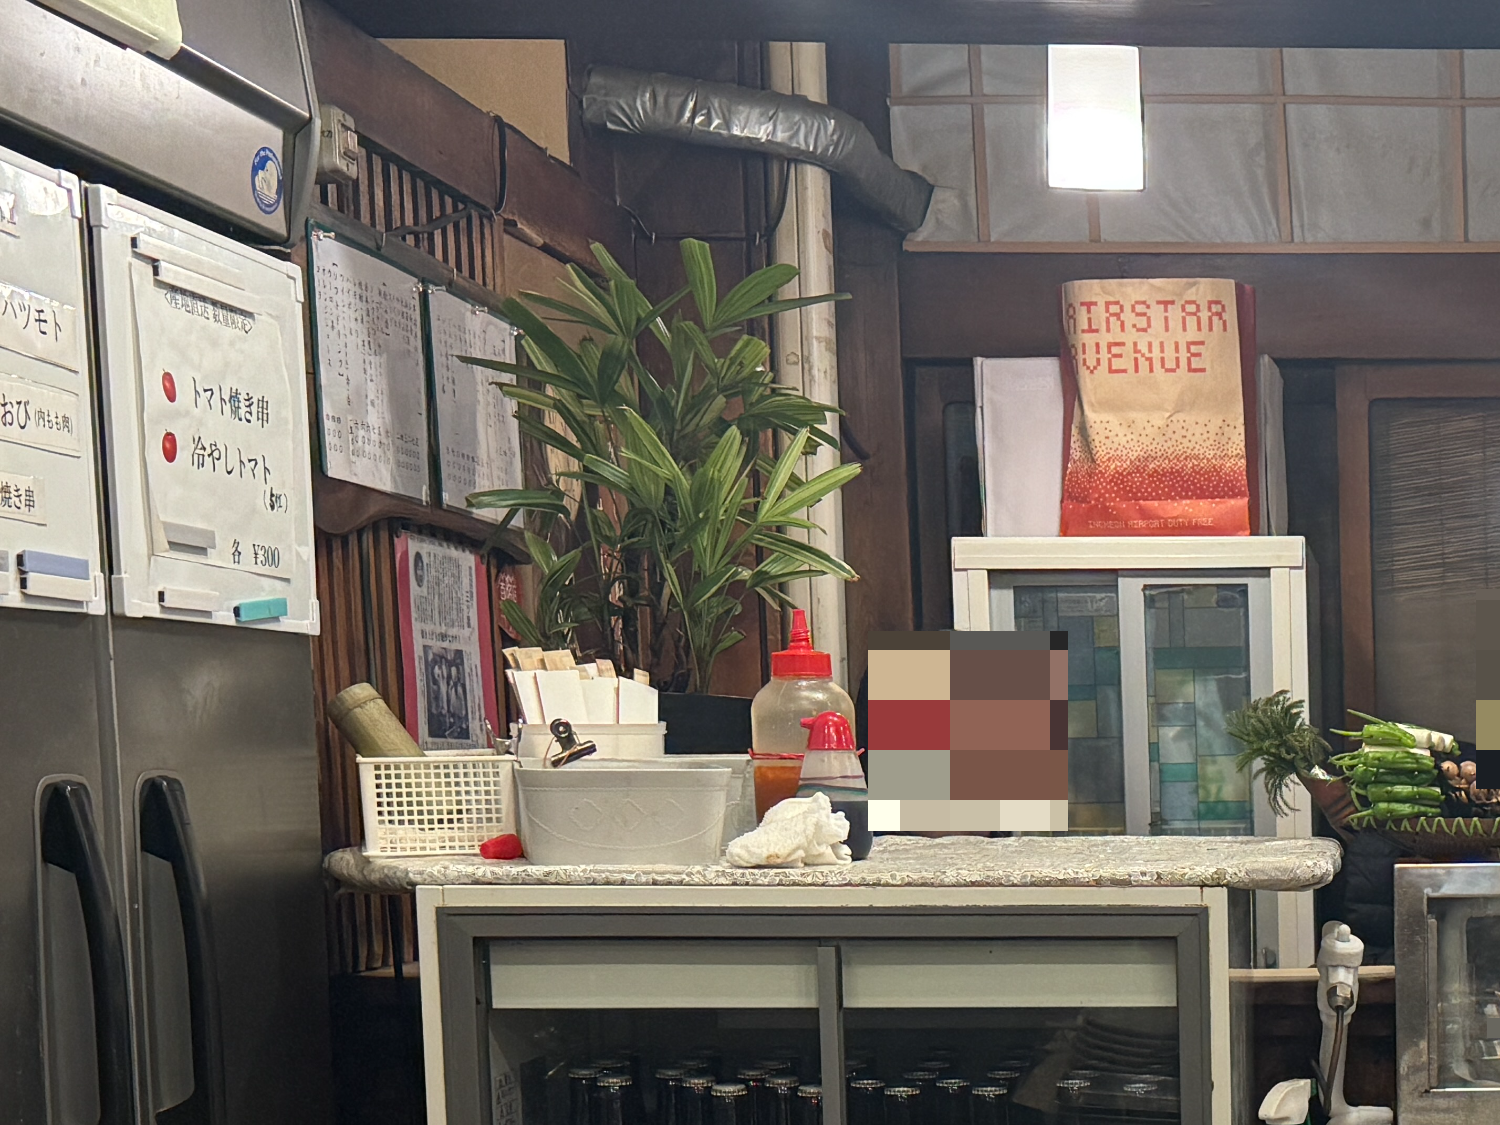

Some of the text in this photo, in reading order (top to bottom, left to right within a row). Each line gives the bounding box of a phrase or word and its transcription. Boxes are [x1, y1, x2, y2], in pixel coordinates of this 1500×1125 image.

[1, 300, 62, 342] ハツモト
[1066, 299, 1228, 334] AIRSTAR
[191, 376, 270, 429] トマト焼き串
[191, 434, 271, 485] 冷やしトマト
[0, 480, 35, 513] 焼き串
[1167, 518, 1190, 527] DUTY
[1192, 517, 1214, 527] FREE
[231, 538, 281, 569] 各 ¥300
